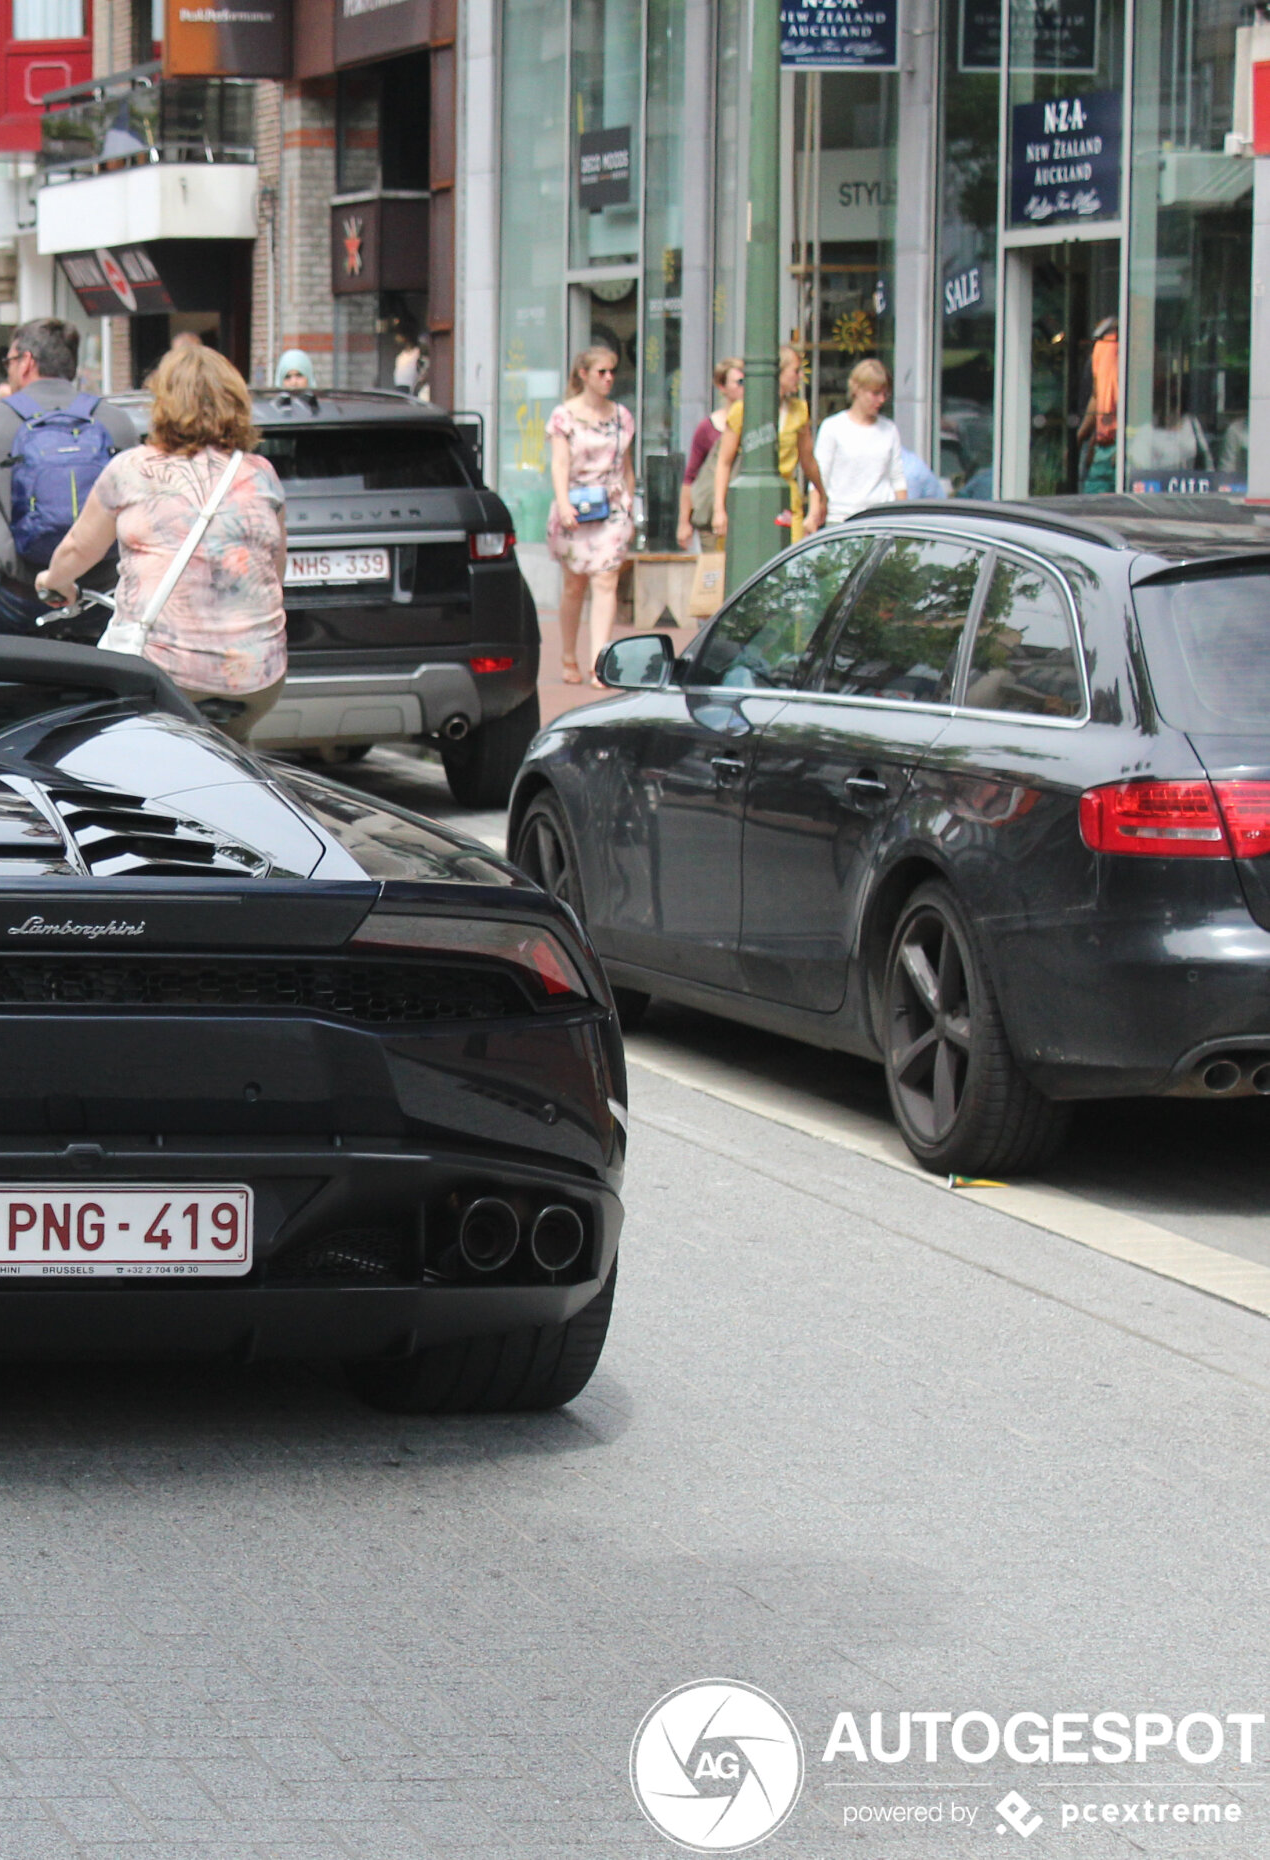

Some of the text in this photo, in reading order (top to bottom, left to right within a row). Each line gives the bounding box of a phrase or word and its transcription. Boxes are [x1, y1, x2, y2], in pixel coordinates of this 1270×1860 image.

[816, 10, 886, 24] ZEALAND
[788, 24, 872, 37] AUCKLAND
[1026, 136, 1102, 162] NEW ZEALAND
[1034, 162, 1092, 186] AUCKLAND
[945, 267, 980, 315] SALE
[331, 507, 422, 521] ROVER
[7, 915, 146, 939] Lamborghini
[42, 1266, 95, 1274] BRUSSELS
[146, 1266, 152, 1274] 2
[155, 1266, 171, 1274] 704
[174, 1266, 185, 1274] 99
[187, 1266, 199, 1274] 30
